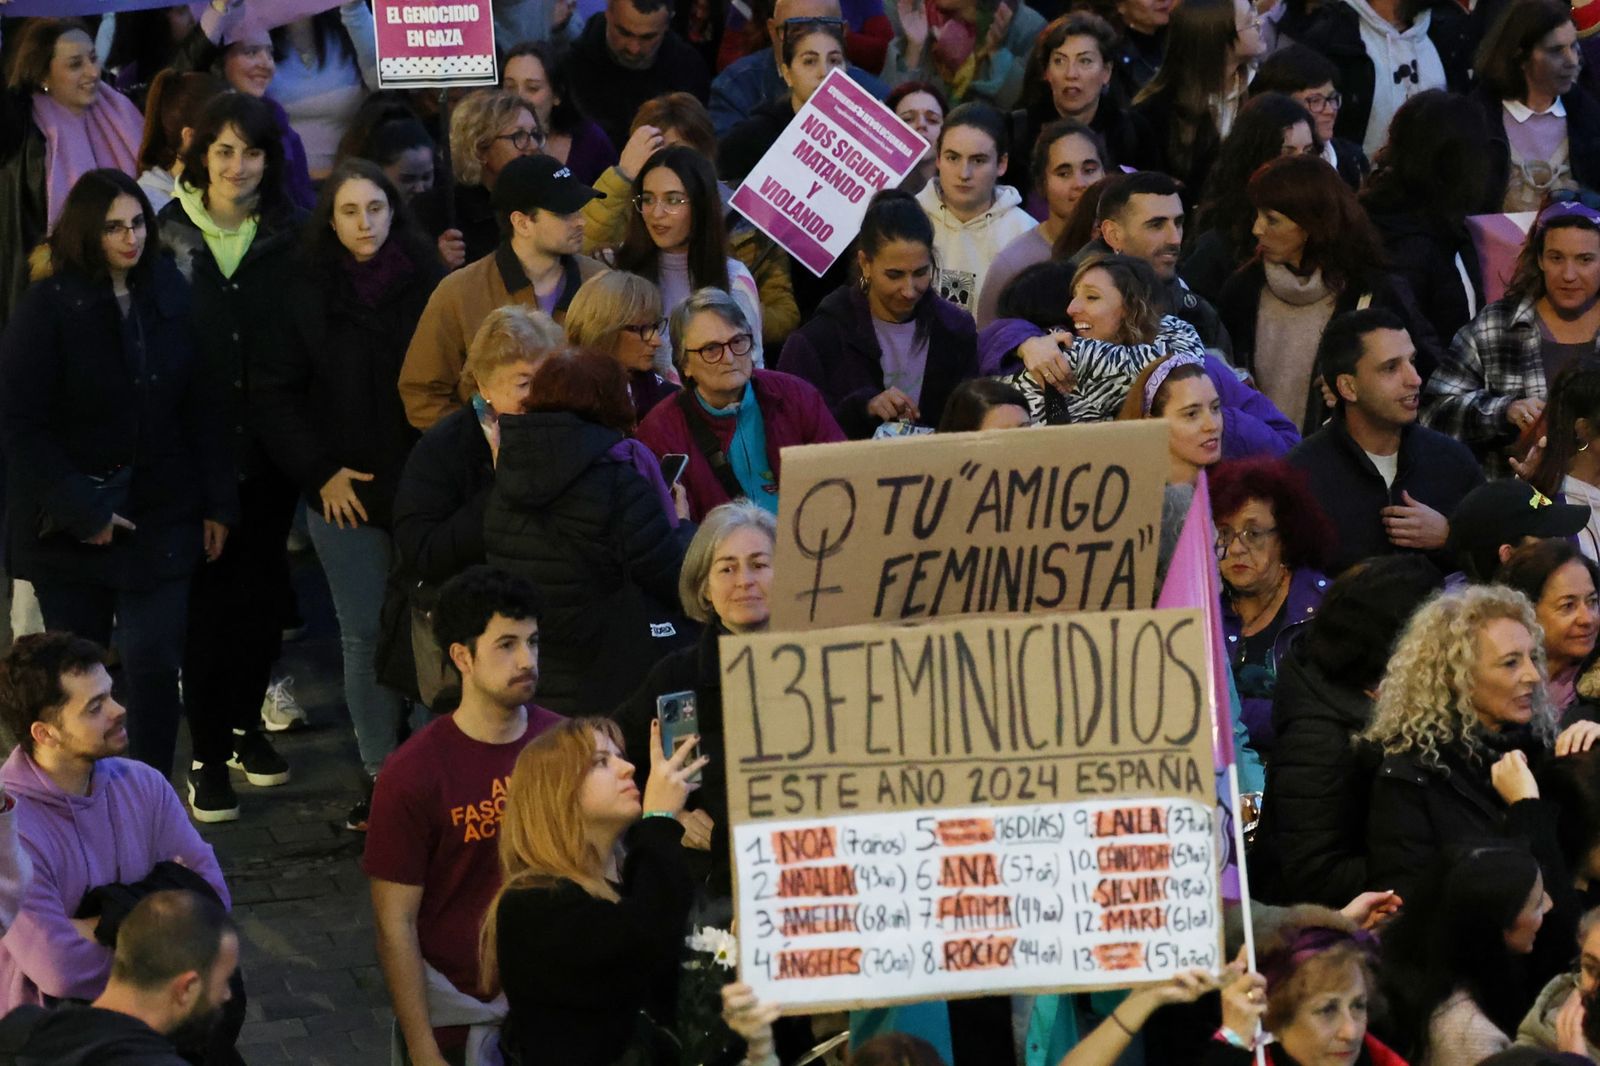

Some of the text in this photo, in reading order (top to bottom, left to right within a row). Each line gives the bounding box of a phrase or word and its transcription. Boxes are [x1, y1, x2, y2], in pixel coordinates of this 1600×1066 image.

[386, 4, 480, 24] EL GENOCIDIO
[406, 28, 464, 47] EN GAZA
[800, 113, 837, 149] NOS
[831, 139, 890, 191] SIGUEN
[792, 139, 866, 204] MATANDO
[806, 180, 823, 200] Y
[760, 175, 834, 242] VIOLANDO
[876, 474, 953, 540] TU
[820, 617, 1201, 757] FEMINICIDIOS
[748, 755, 1204, 818] ESTE AÑO 2024 ESPAÑA
[780, 827, 835, 864] NOA
[779, 865, 854, 897] NATALIA
[942, 854, 998, 888] ANA
[1097, 878, 1162, 909] SILVIA
[944, 934, 1011, 971] ROCÍO
